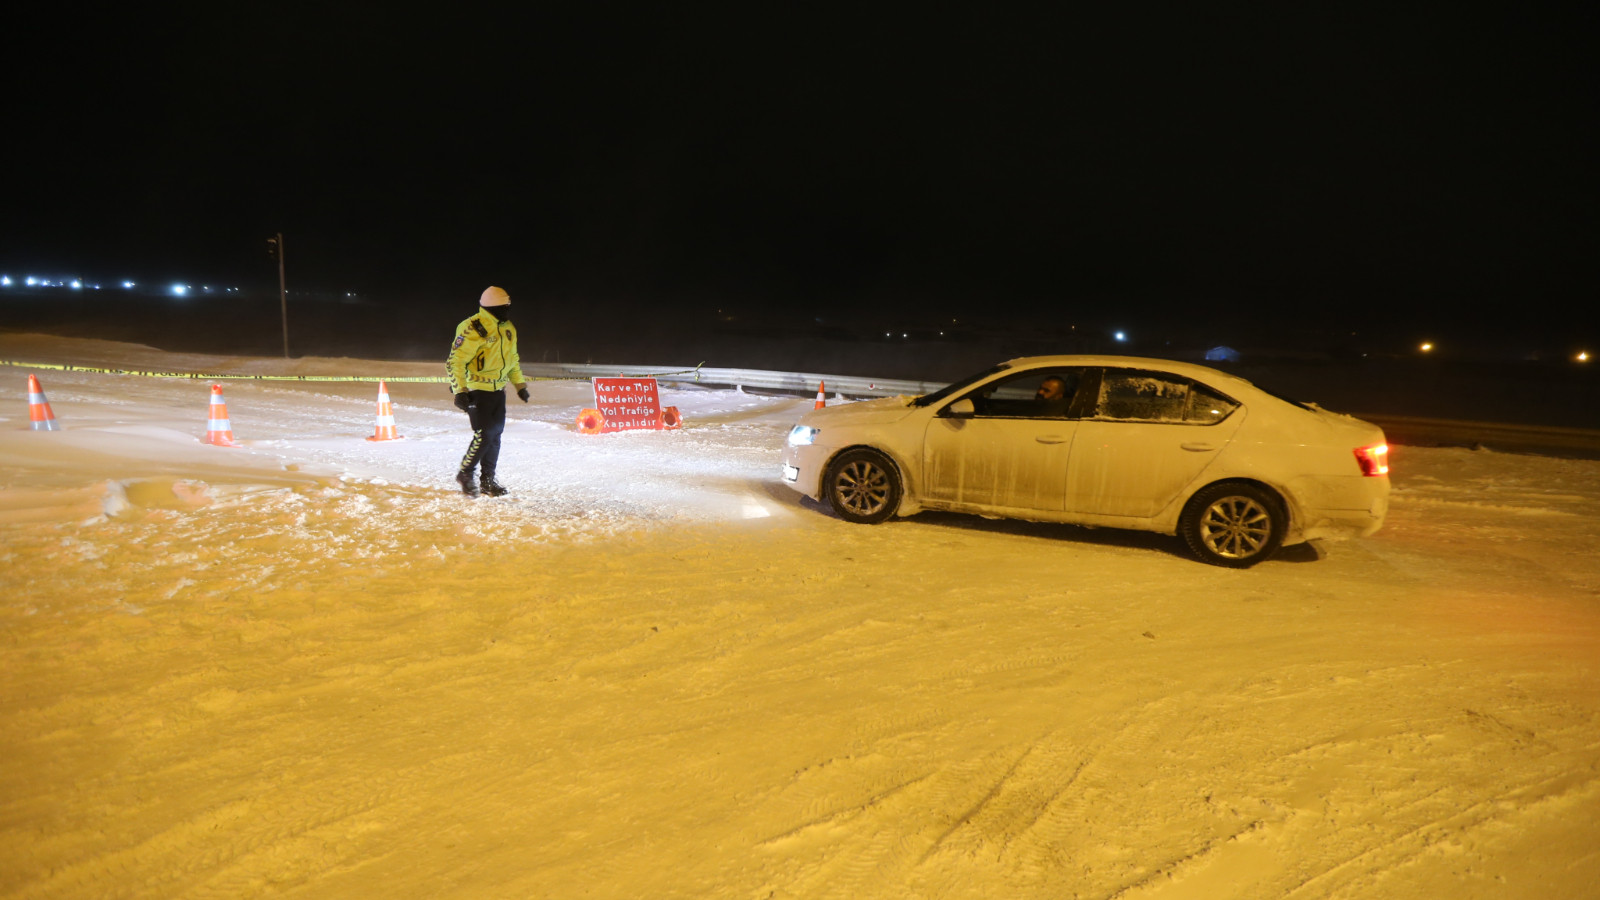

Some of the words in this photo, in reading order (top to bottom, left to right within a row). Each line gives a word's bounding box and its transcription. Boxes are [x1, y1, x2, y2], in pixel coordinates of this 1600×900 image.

[597, 383, 616, 392] Kar
[599, 395, 653, 404] Nedeniyle
[601, 407, 617, 416] Yol
[620, 406, 654, 416] Trafiğe
[604, 419, 656, 430] Kapalıdır
